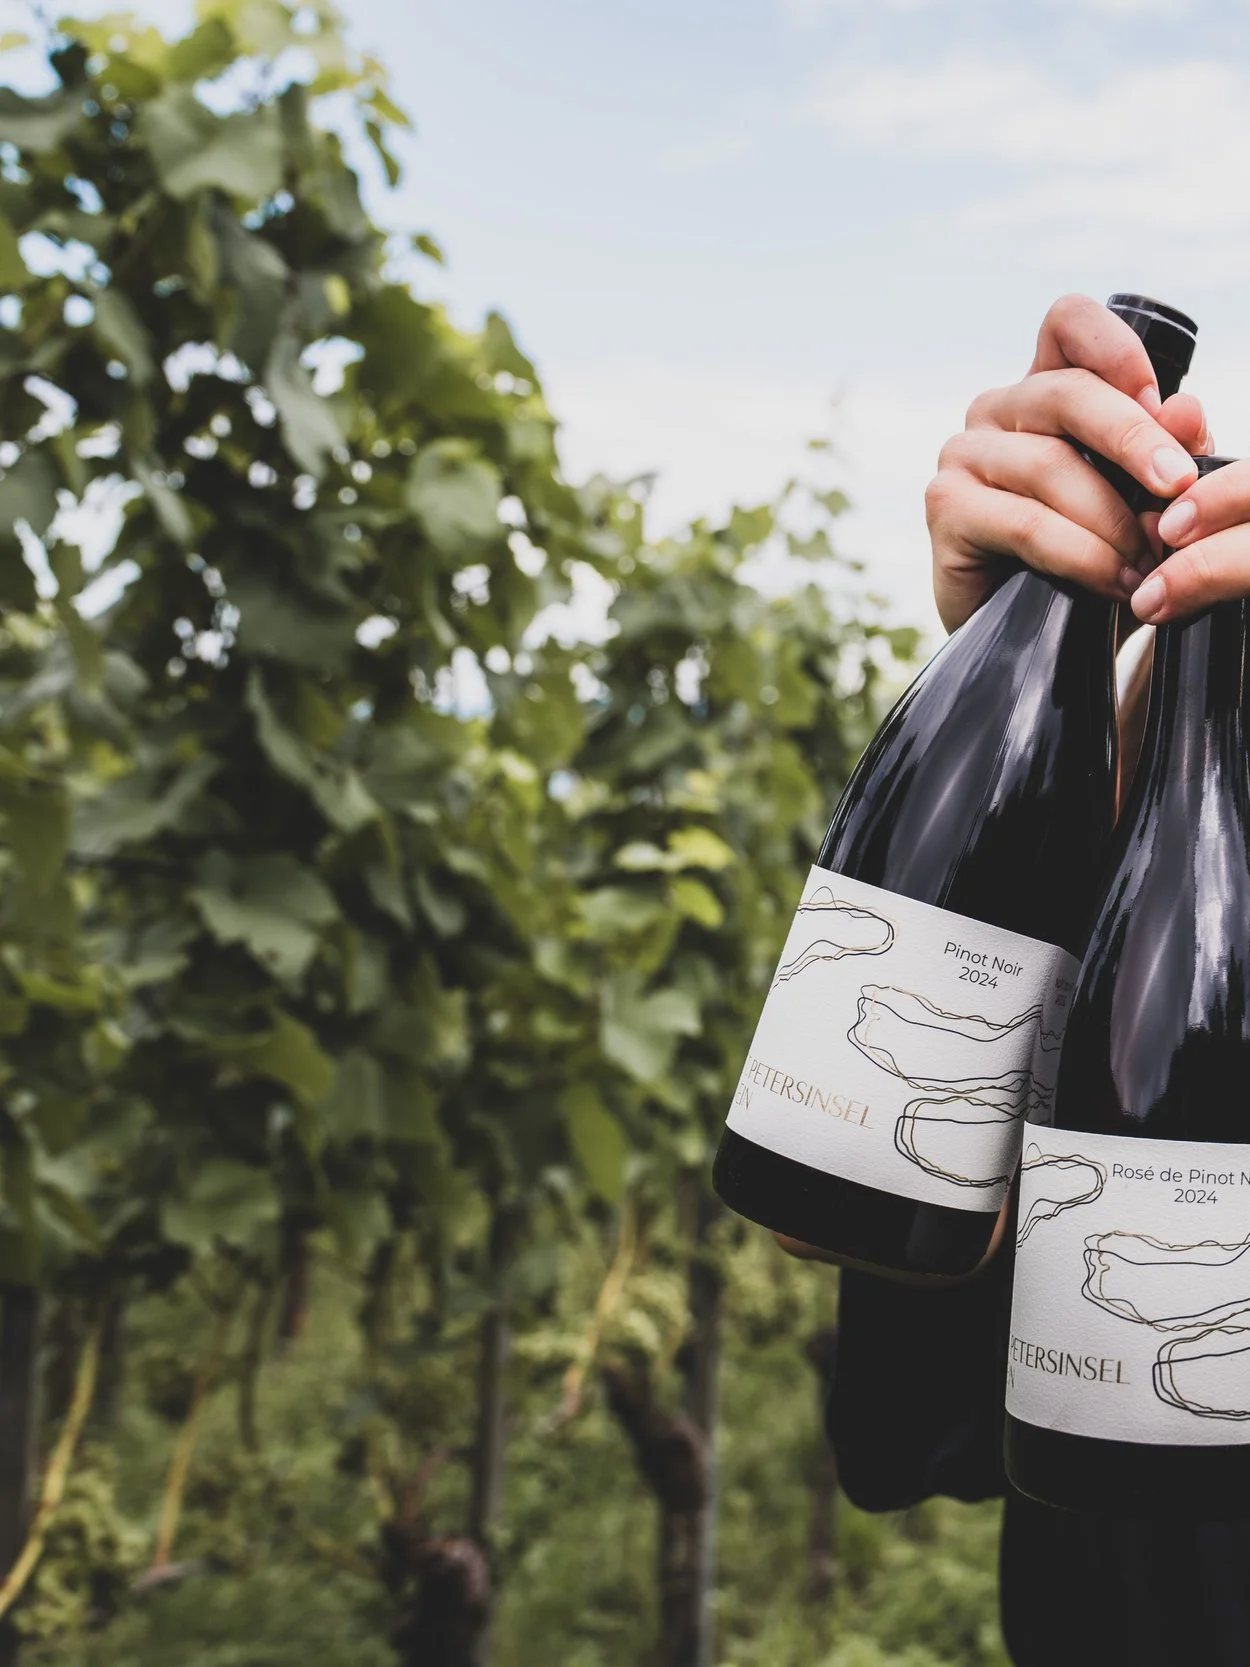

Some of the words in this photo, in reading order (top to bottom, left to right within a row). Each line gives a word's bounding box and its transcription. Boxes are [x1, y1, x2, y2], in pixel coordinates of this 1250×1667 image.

[943, 941, 988, 967] Pinot
[991, 956, 1024, 977] Noir
[958, 966, 998, 989] 2024
[1112, 1163, 1155, 1181] Rosé
[1159, 1167, 1183, 1183] de
[1188, 1169, 1235, 1186] Pinot
[1173, 1188, 1218, 1205] 2024
